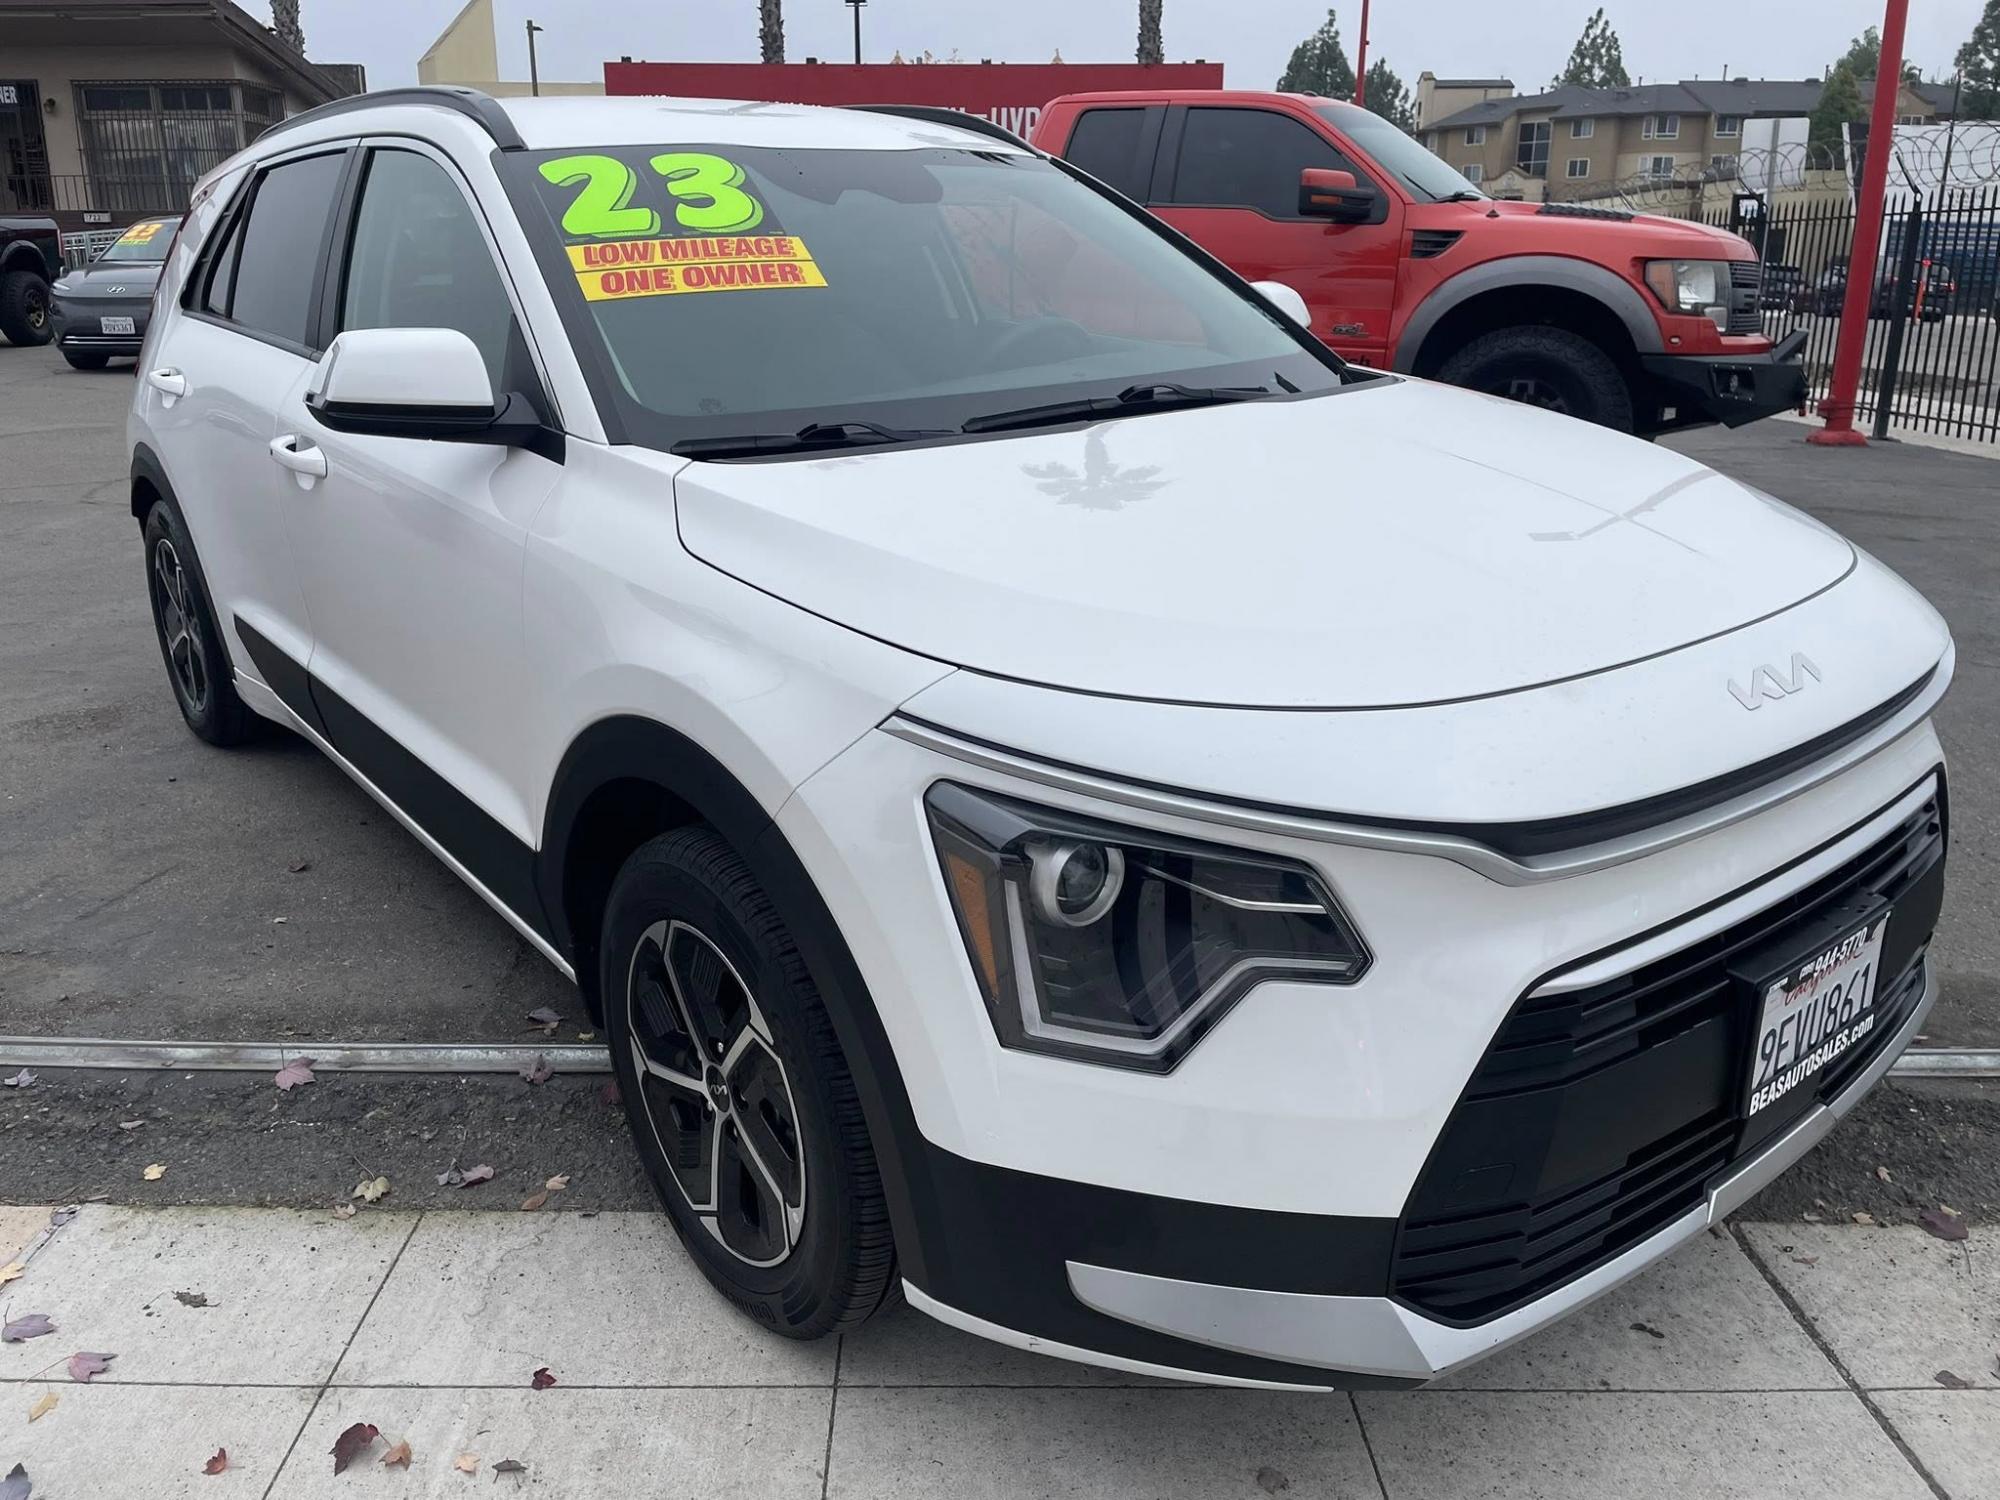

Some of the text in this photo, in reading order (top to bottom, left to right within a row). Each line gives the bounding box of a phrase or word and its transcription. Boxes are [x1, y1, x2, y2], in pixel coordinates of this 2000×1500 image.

[538, 152, 763, 238] 23
[583, 237, 798, 268] LOW MILEAGE
[600, 263, 806, 295] ONE OWNER
[1814, 926, 1868, 976] 944-5770
[1756, 962, 1871, 1088] 9EVU861
[1749, 1013, 1875, 1117] BEASAUTOSALES.com
